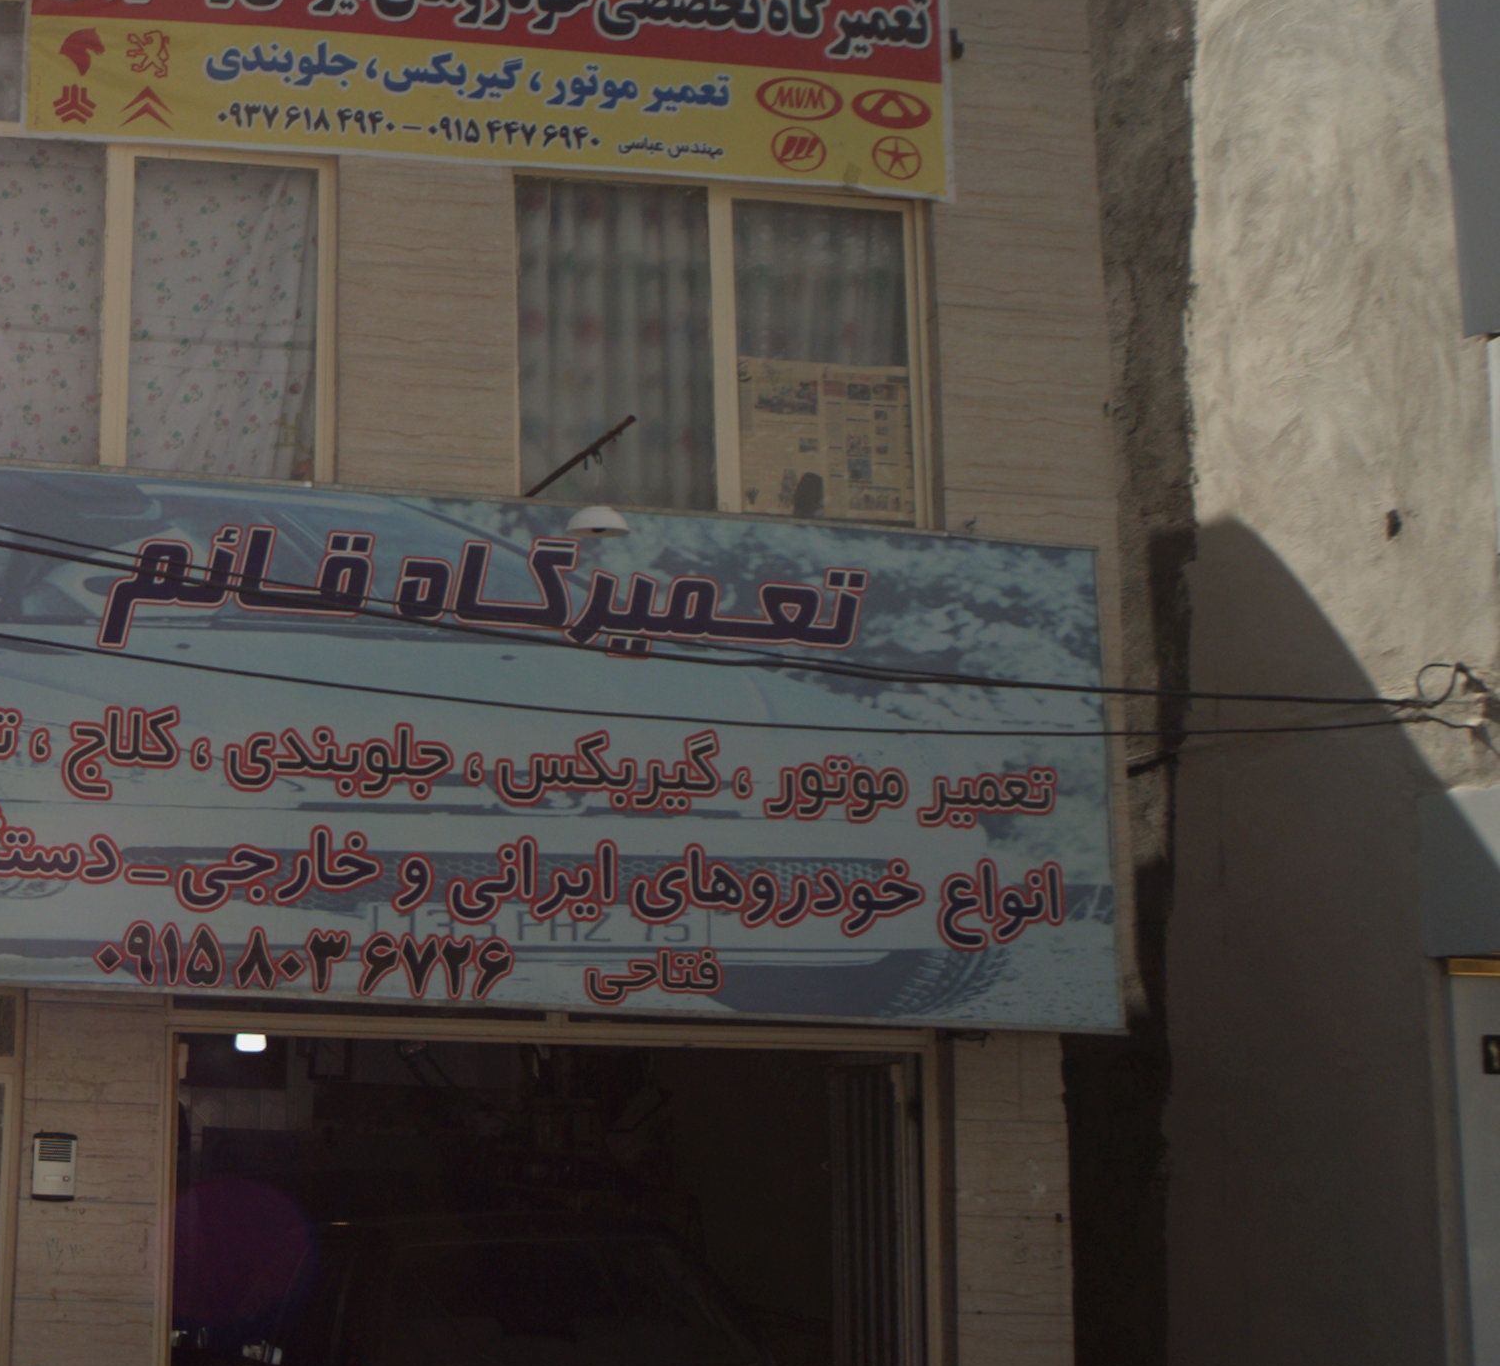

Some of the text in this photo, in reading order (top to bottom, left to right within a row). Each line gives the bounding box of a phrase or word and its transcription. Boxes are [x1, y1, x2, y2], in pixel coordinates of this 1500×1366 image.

[206, 41, 358, 89] جلوبندی
[548, 64, 637, 110] موتور
[644, 74, 730, 113] تعمیر
[771, 85, 827, 111] MVM
[618, 136, 724, 159] مهندس عباسی
[99, 524, 869, 656] تعمیرگاه قائم
[226, 723, 452, 800] جلوبندی
[497, 730, 719, 812] گیربکس
[765, 757, 907, 821] موتور
[918, 765, 1057, 828] تعمیر
[176, 825, 380, 913] خارجی
[396, 852, 433, 911] و
[450, 835, 618, 926] ایرانی
[632, 844, 924, 936] خودروهای
[938, 858, 1064, 951] انواع
[583, 946, 726, 1006] فتاحی
